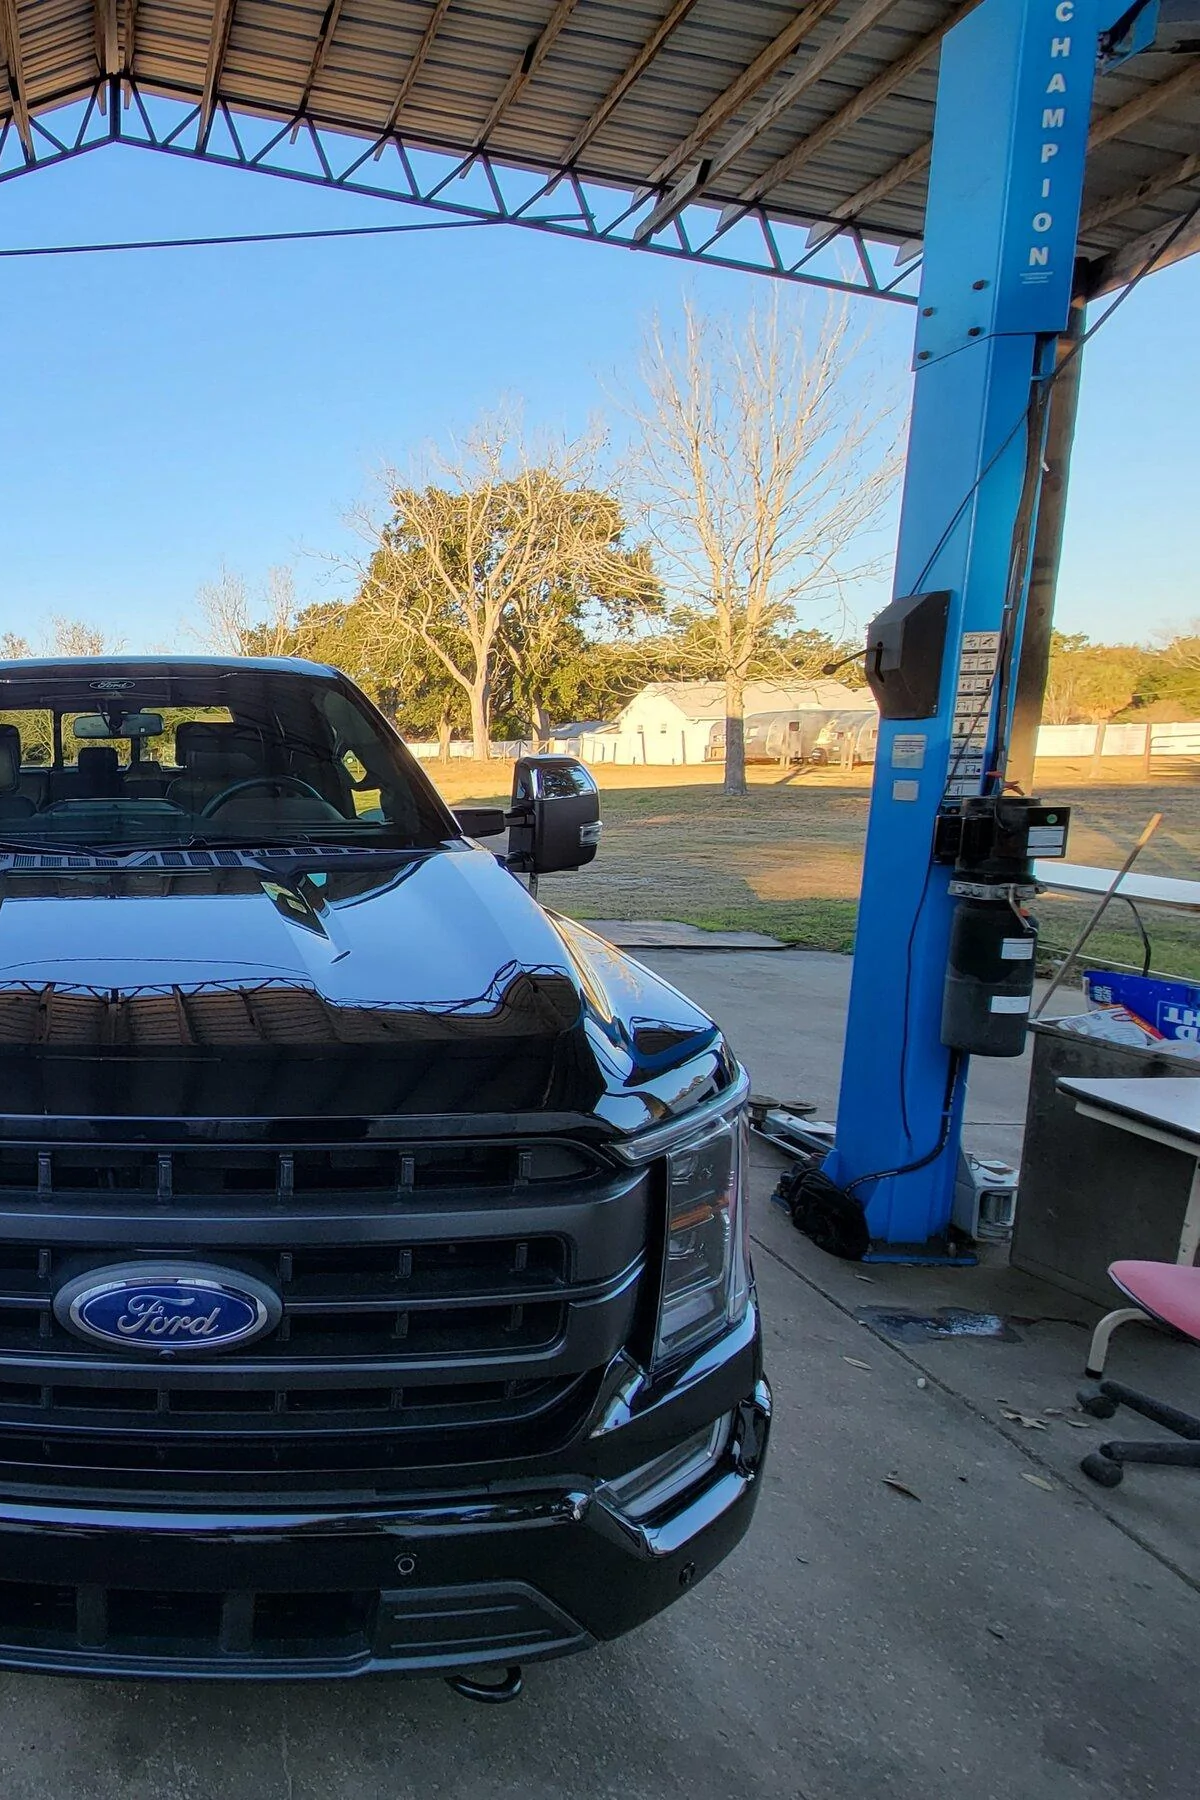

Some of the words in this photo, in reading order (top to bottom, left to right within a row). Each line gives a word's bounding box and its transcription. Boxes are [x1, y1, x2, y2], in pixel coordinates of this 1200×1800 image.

[1029, 1, 1075, 267] CHAMPION
[97, 680, 128, 689] Ford
[116, 1294, 221, 1336] Ford
